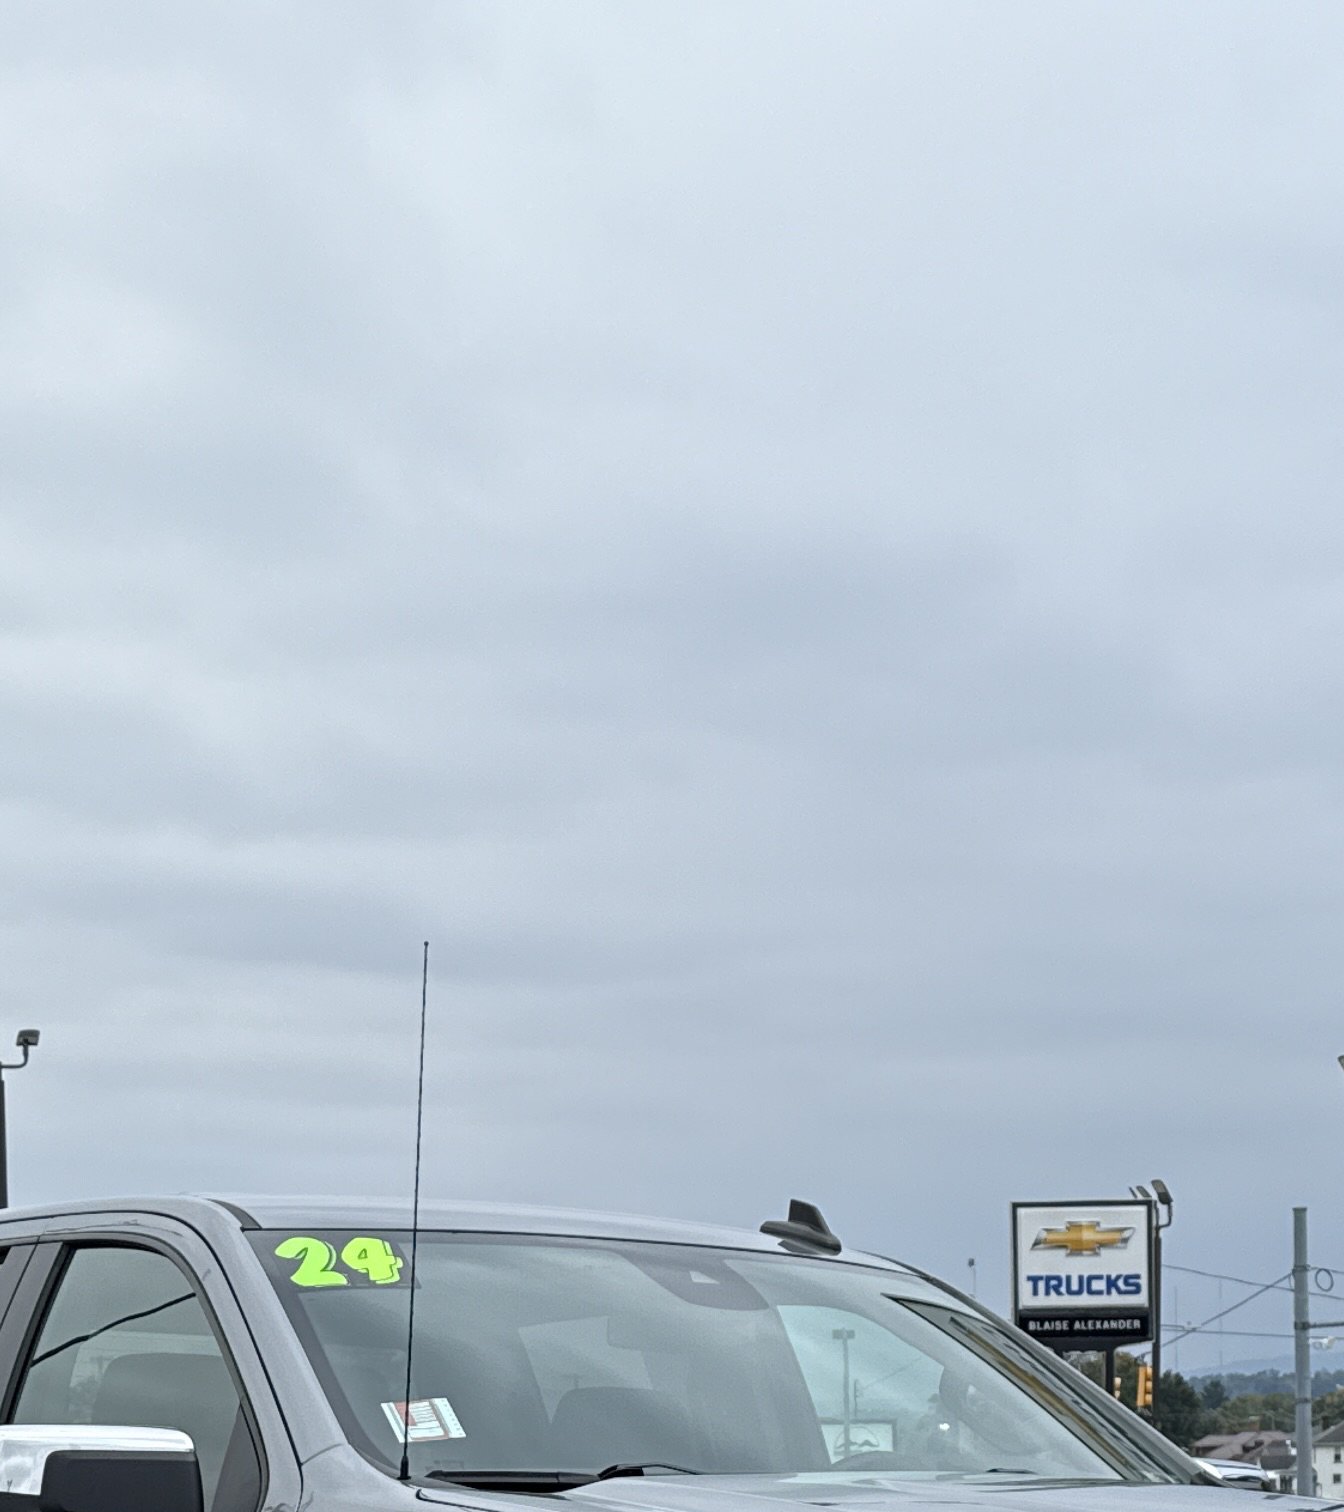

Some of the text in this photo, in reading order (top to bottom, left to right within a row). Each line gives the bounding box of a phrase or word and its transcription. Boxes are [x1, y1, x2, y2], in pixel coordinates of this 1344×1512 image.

[274, 1236, 404, 1288] 24
[1026, 1274, 1142, 1297] TRUCKS
[1028, 1319, 1141, 1331] BLAISE ALEXANDER
